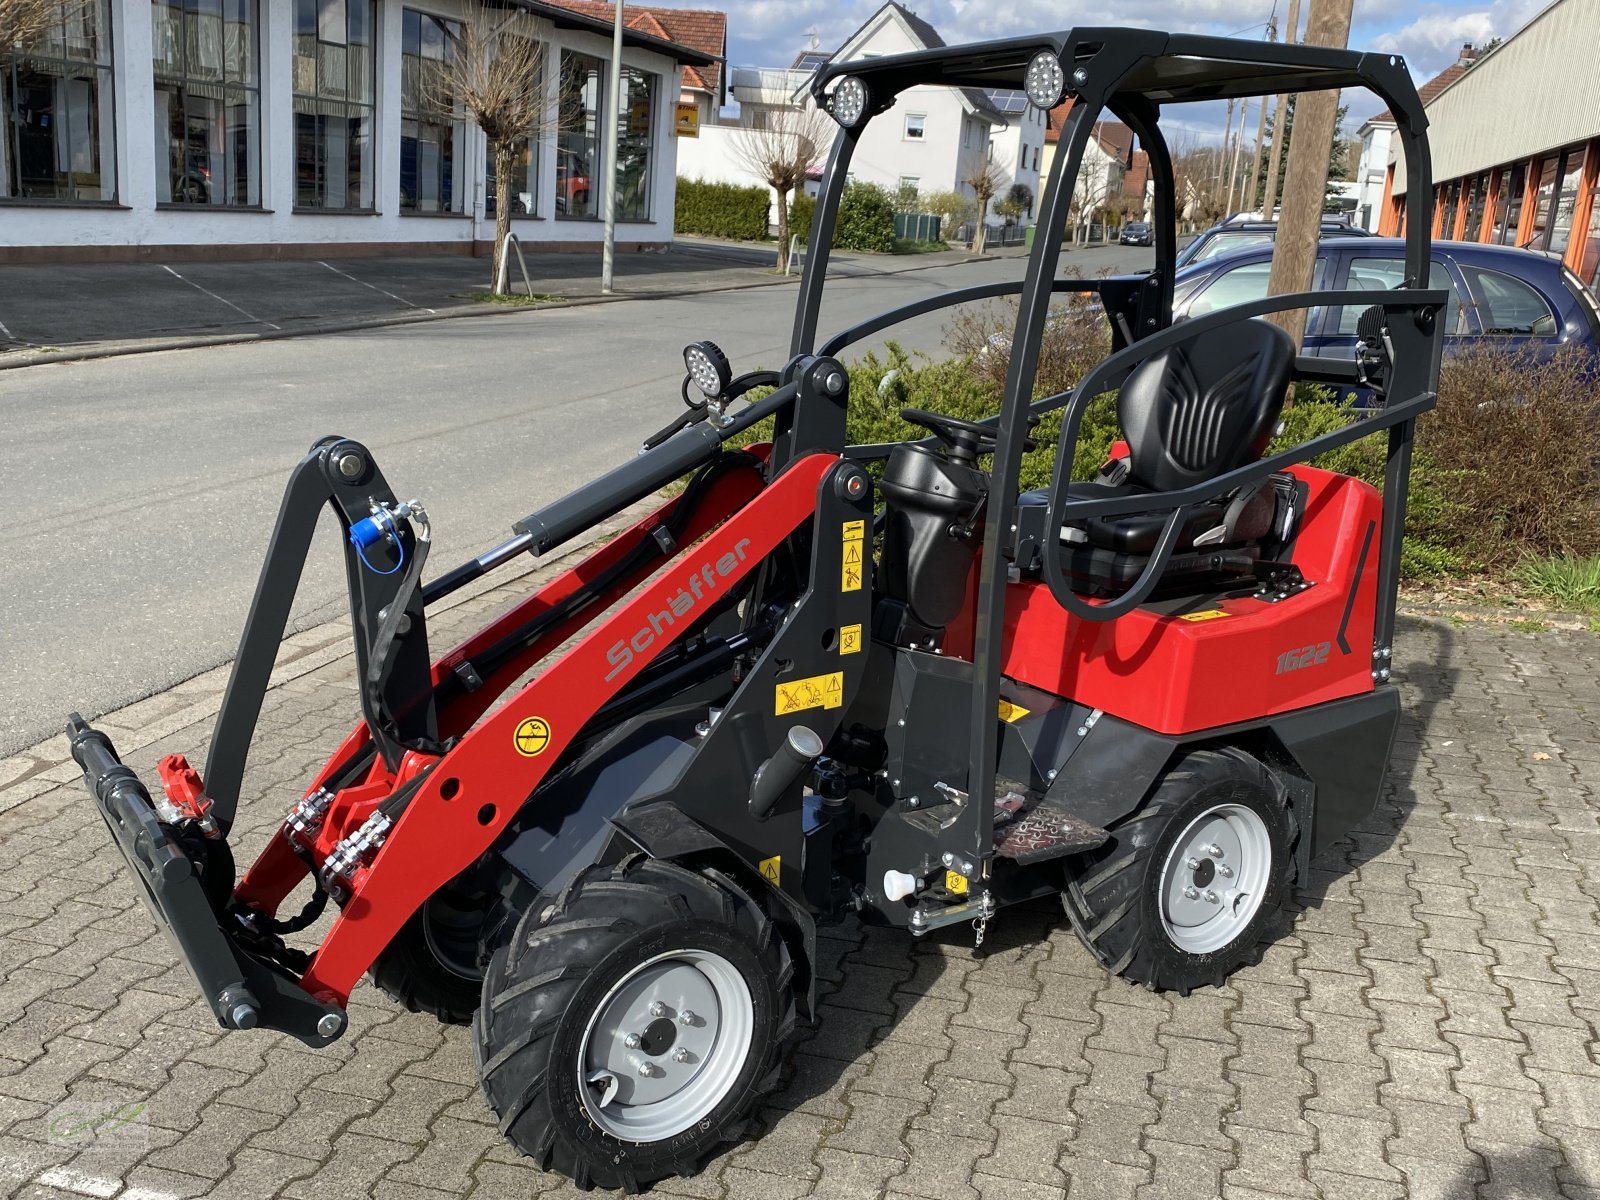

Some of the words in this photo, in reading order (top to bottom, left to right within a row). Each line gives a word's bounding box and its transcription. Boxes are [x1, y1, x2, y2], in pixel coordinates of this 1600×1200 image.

[677, 104, 698, 112] STIHL
[604, 537, 751, 683] Schäffer
[1275, 641, 1332, 675] 1622
